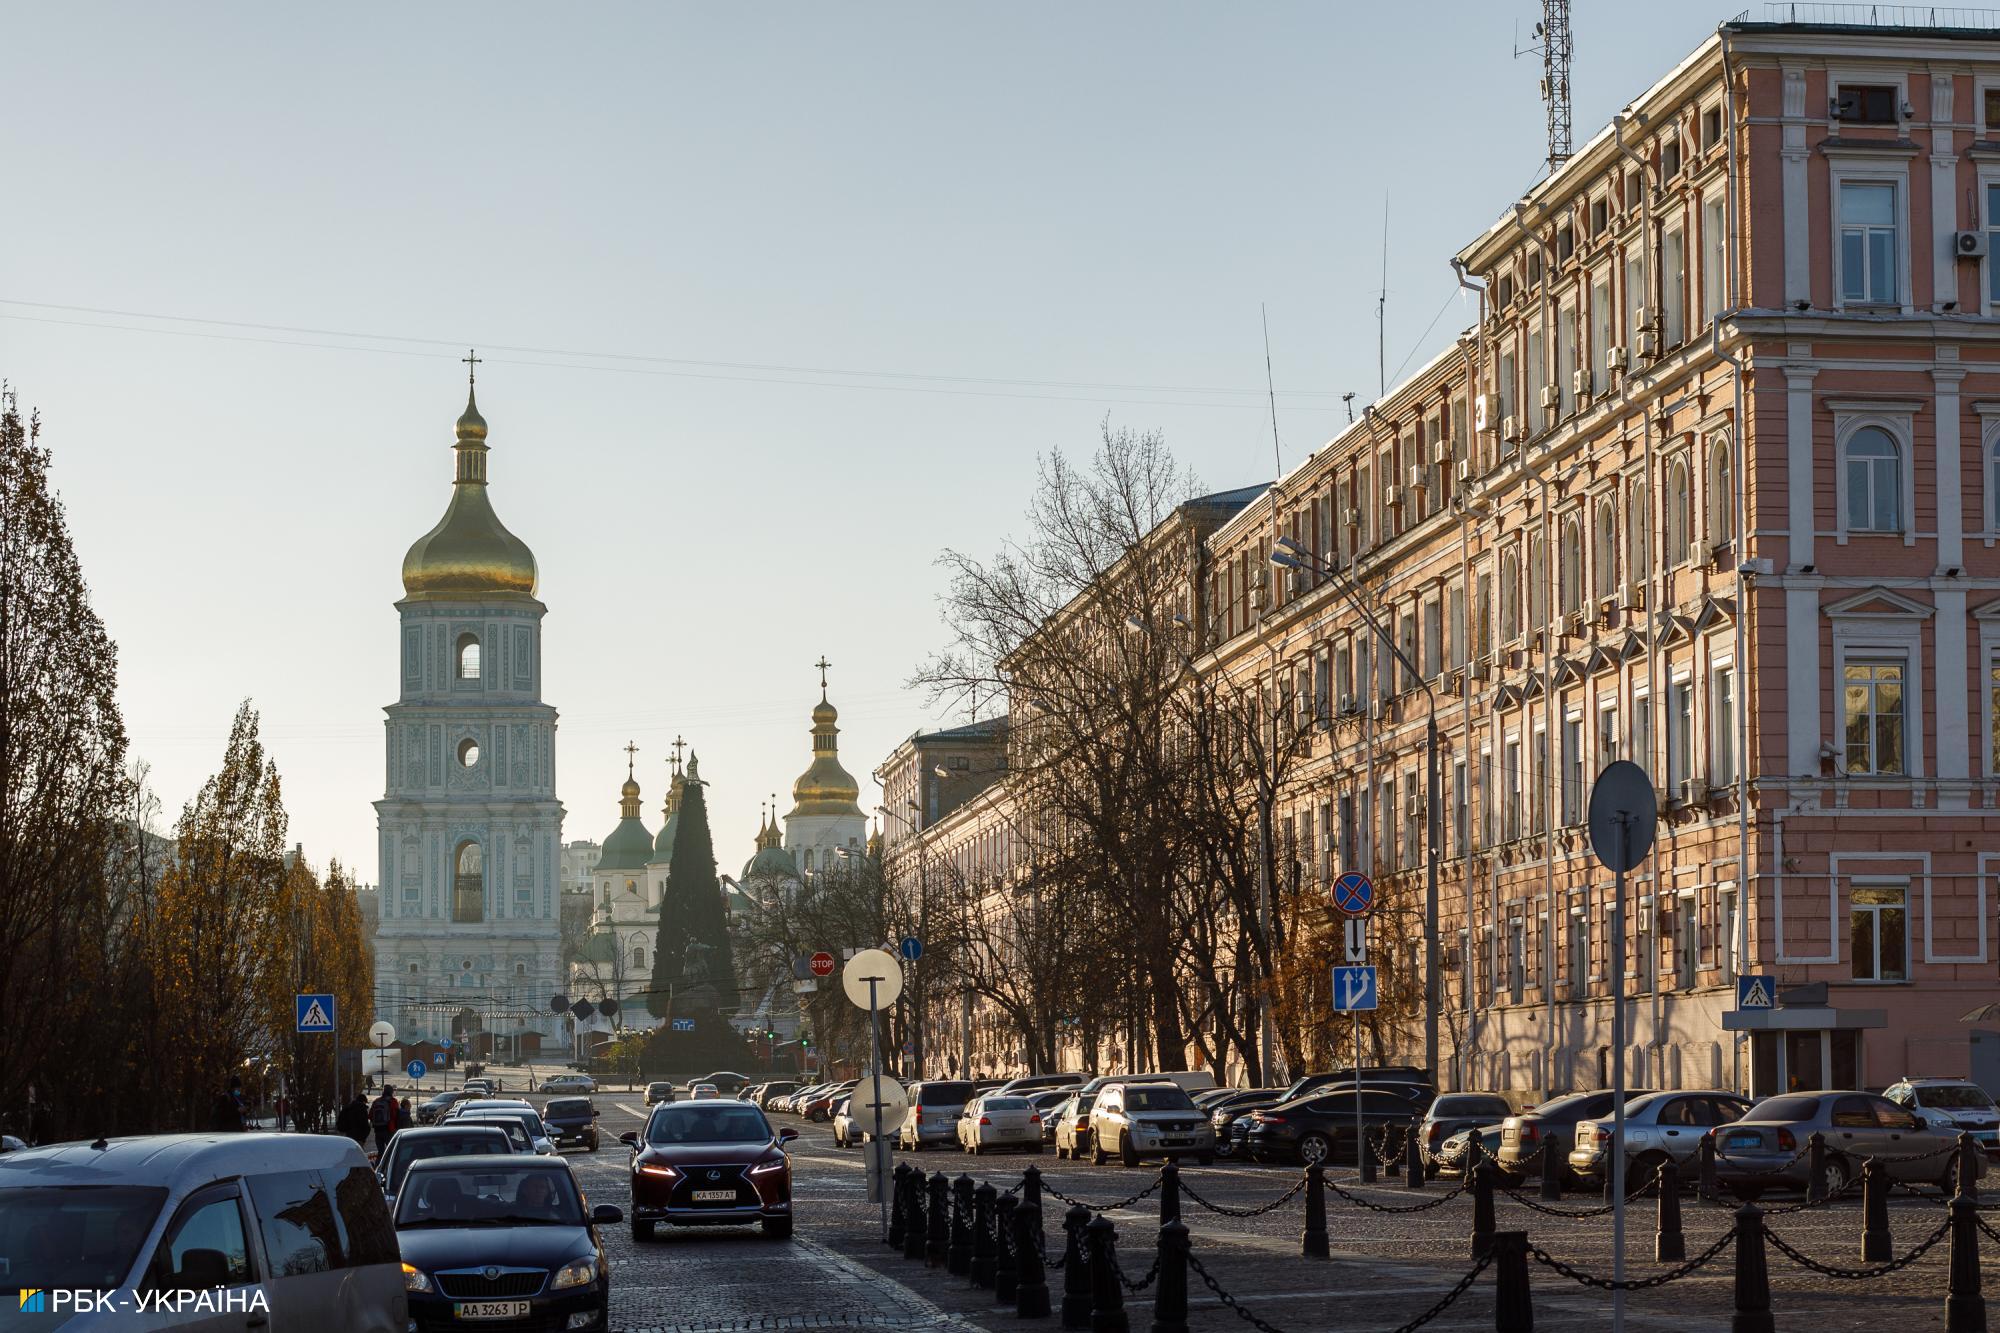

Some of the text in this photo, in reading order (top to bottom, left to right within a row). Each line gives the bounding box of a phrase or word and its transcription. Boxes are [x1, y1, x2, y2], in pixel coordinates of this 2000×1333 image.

[811, 960, 833, 968] STOP
[696, 1191, 735, 1199] KA 1357 AT
[462, 1304, 479, 1317] AA
[481, 1303, 509, 1316] 3263
